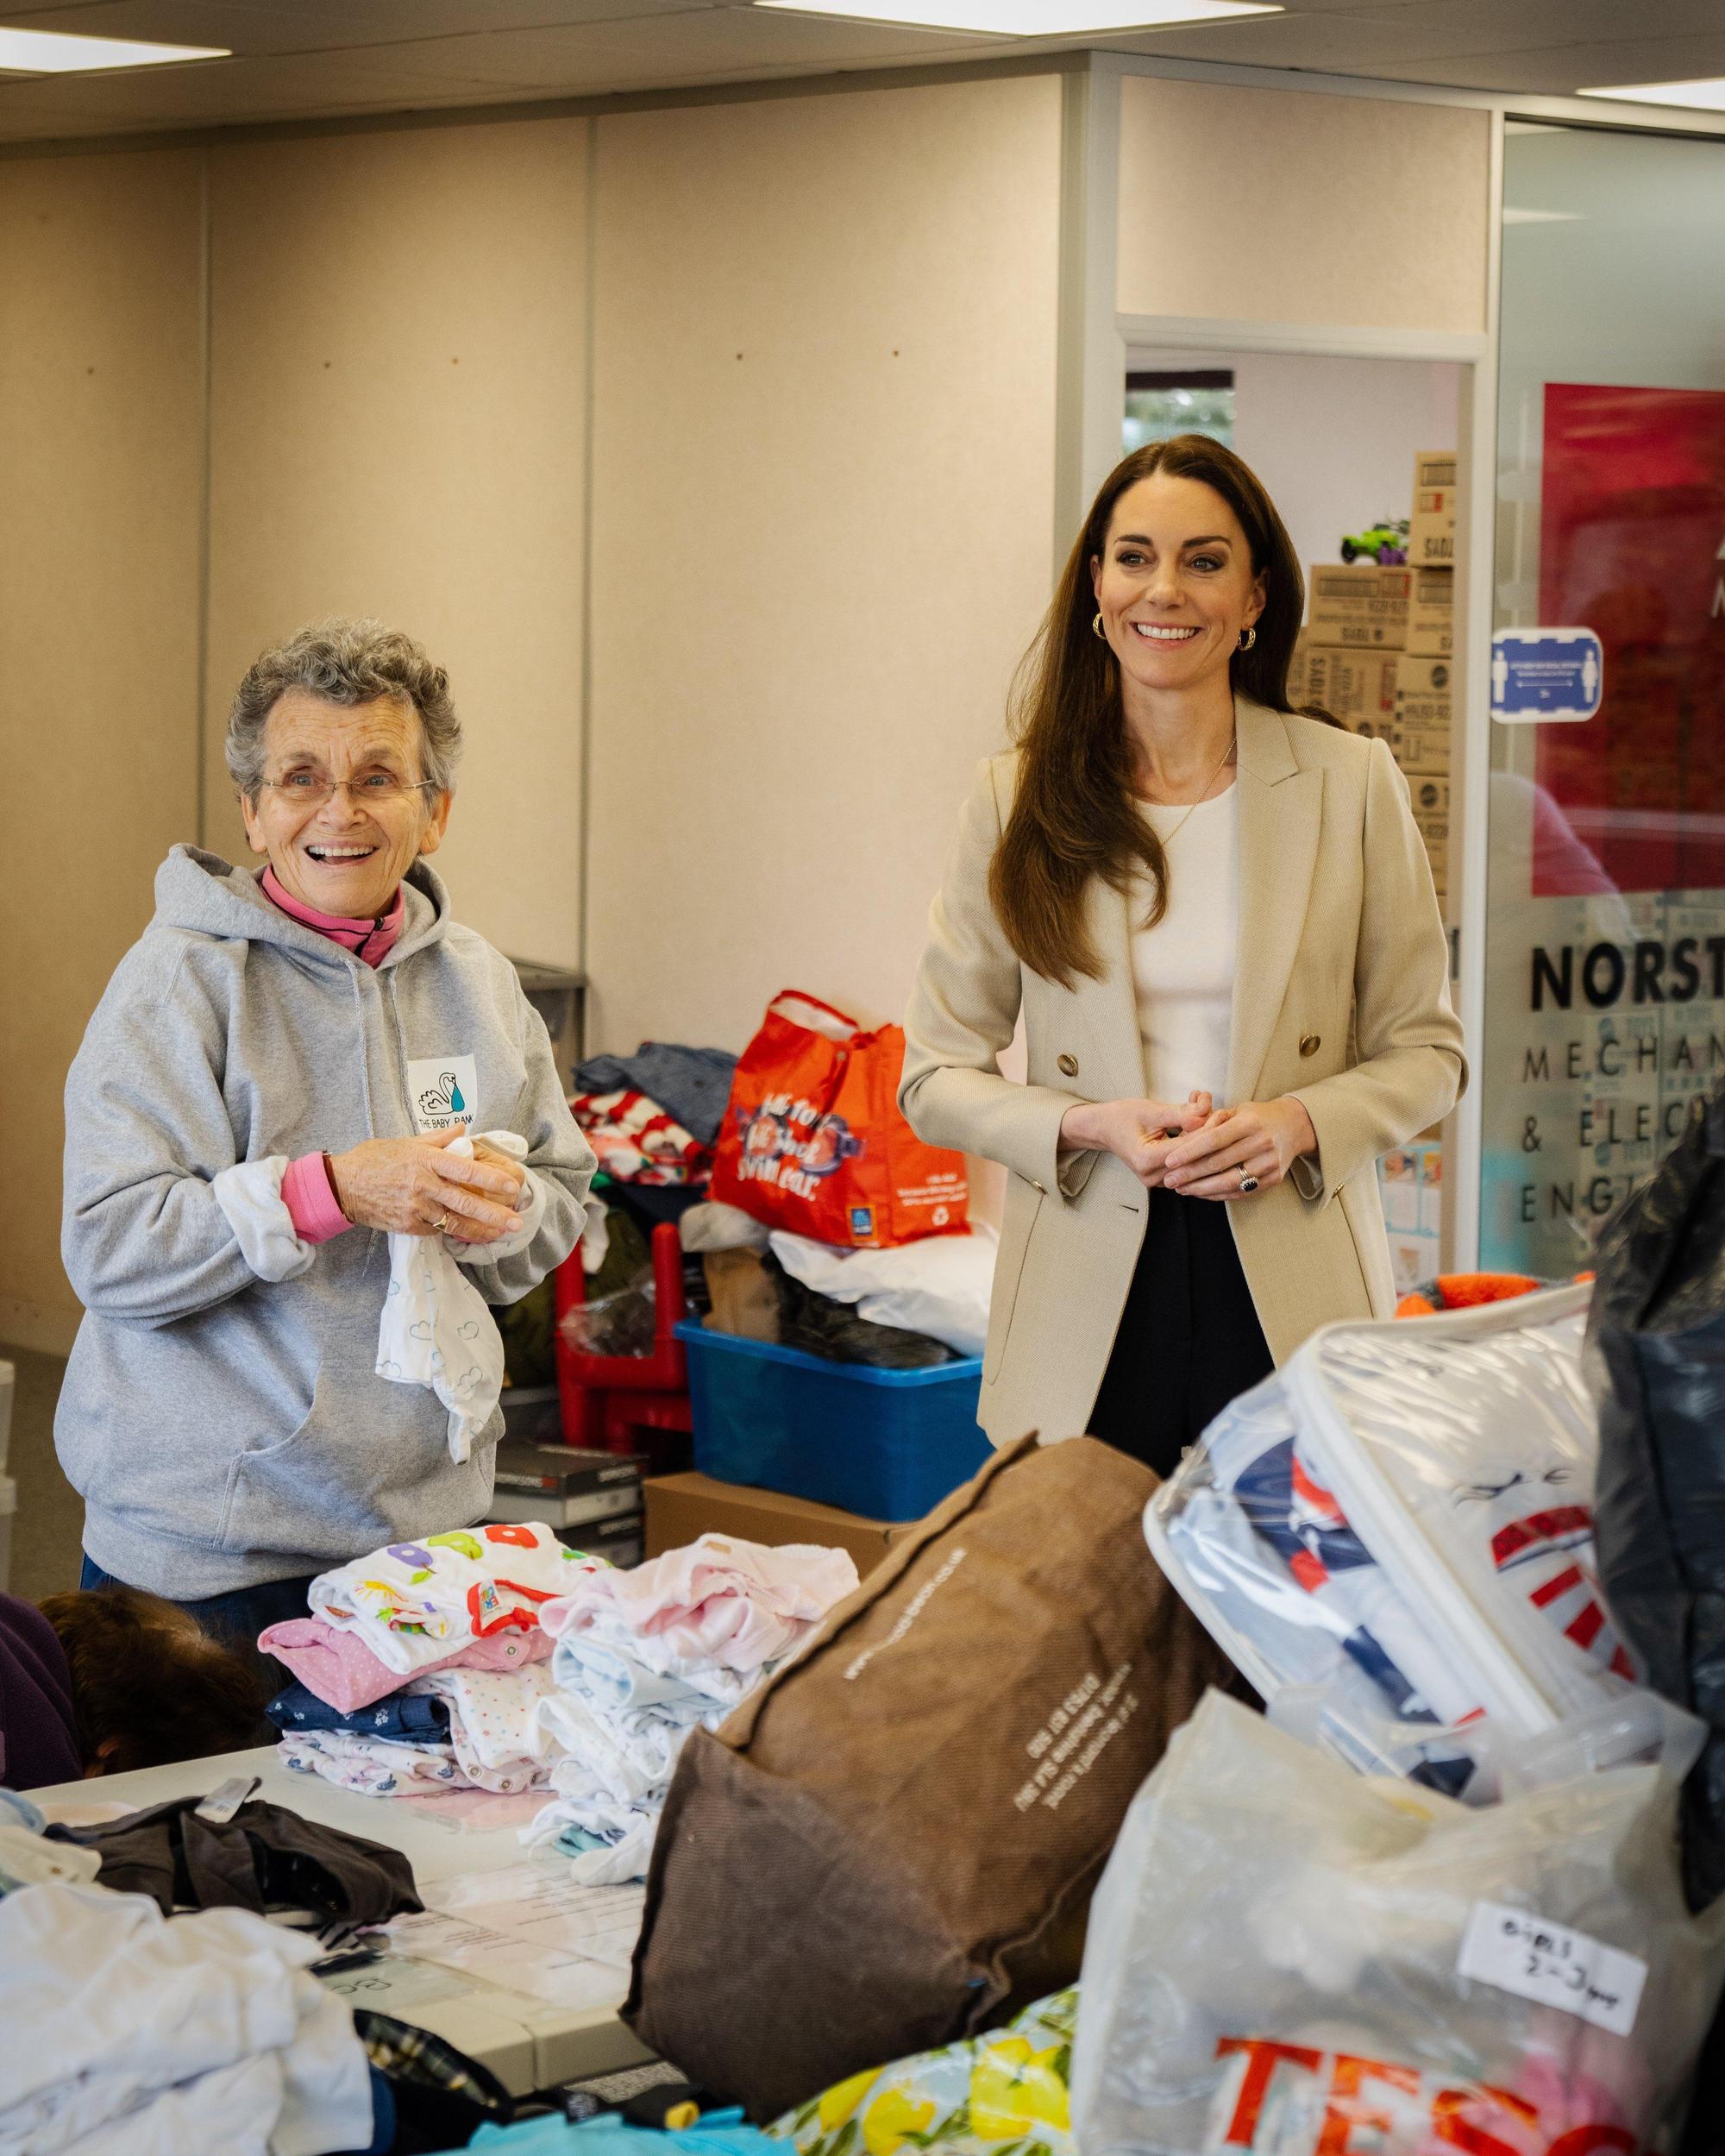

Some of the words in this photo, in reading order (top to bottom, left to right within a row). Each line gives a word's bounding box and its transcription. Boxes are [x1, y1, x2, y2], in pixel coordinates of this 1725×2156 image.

[1531, 938, 1725, 1011] NORST
[418, 1118, 431, 1128] THE
[432, 1118, 450, 1128] BABY
[1521, 1116, 1541, 1153] &
[1215, 2036, 1640, 2156] TES
